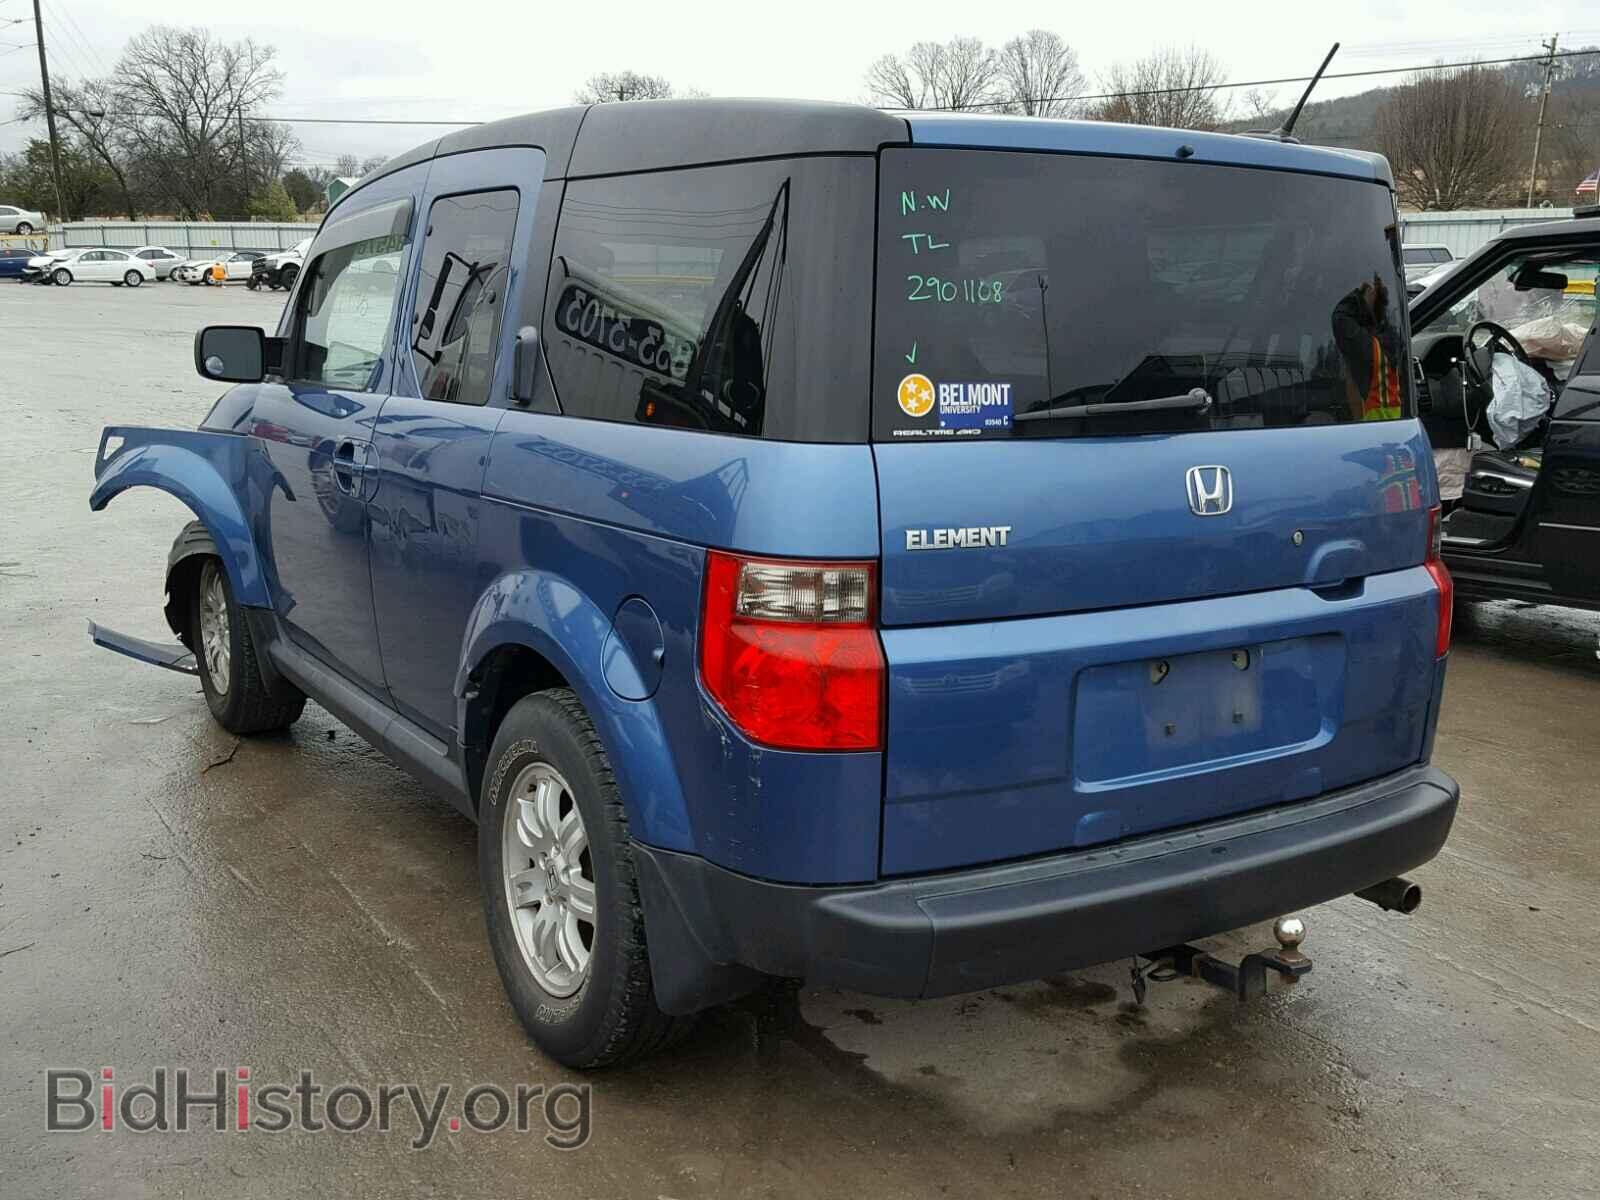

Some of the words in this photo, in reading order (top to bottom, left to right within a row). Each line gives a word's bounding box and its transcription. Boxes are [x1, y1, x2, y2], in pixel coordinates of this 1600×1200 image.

[938, 383, 1011, 405] BELMONT
[940, 405, 981, 414] UNIVERSITY
[905, 526, 1012, 551] ELEMENT
